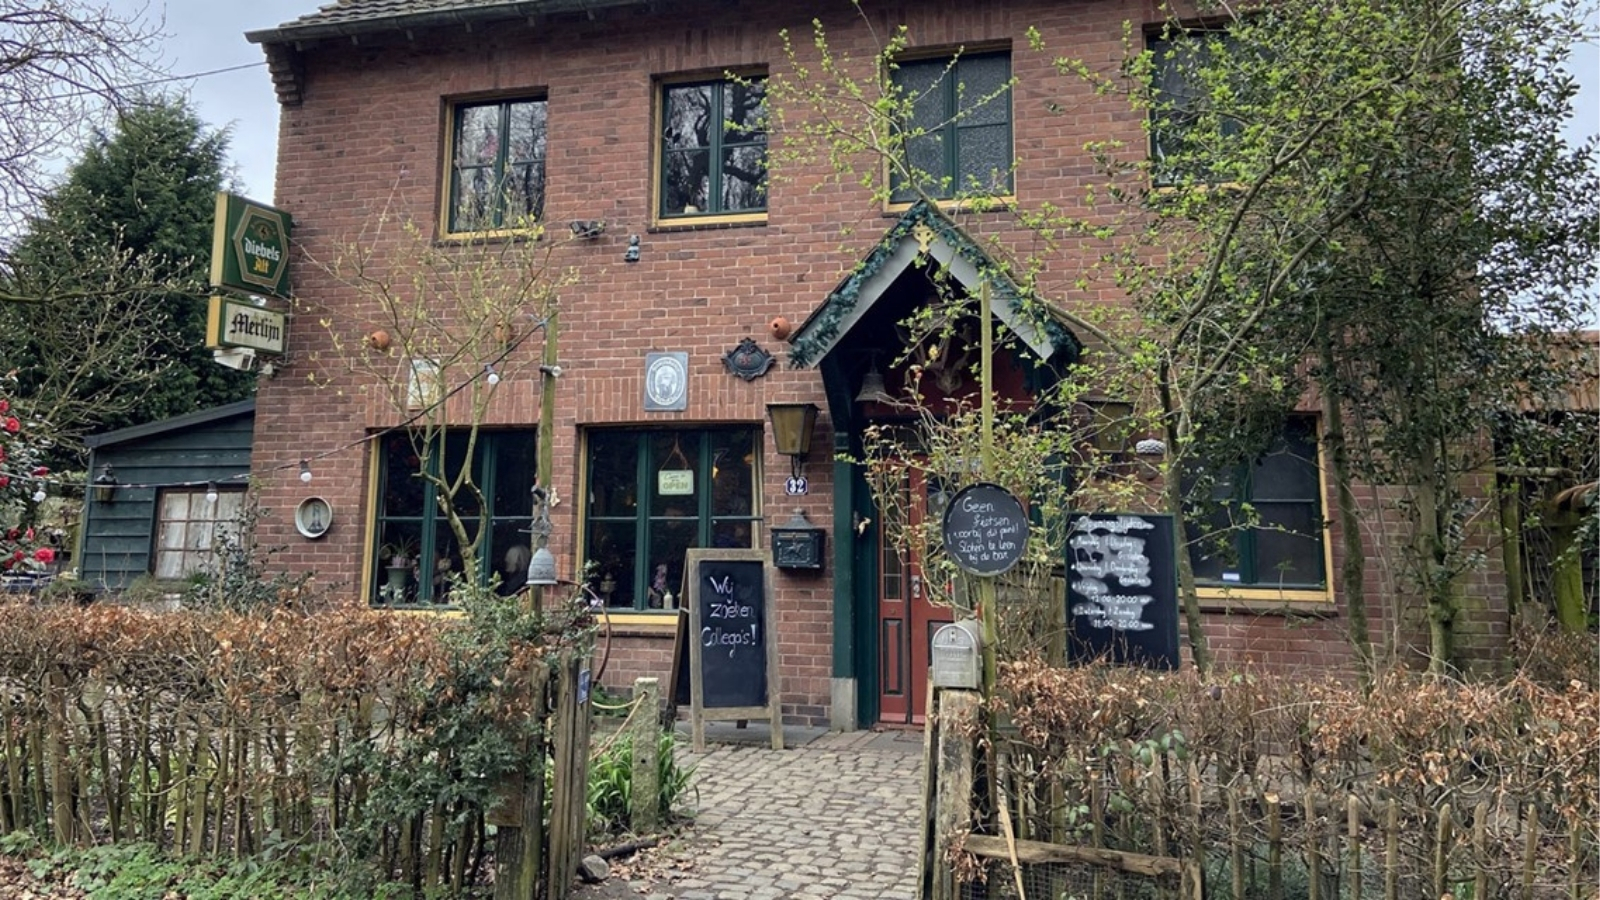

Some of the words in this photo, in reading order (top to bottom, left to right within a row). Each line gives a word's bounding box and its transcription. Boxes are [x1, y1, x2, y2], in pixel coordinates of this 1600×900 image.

[245, 237, 280, 261] Diebels
[253, 257, 269, 274] Alt
[229, 313, 280, 343] Merlijn
[663, 482, 688, 490] OPEN
[790, 479, 804, 493] 32
[963, 496, 995, 512] Geen
[709, 576, 734, 604] Wij
